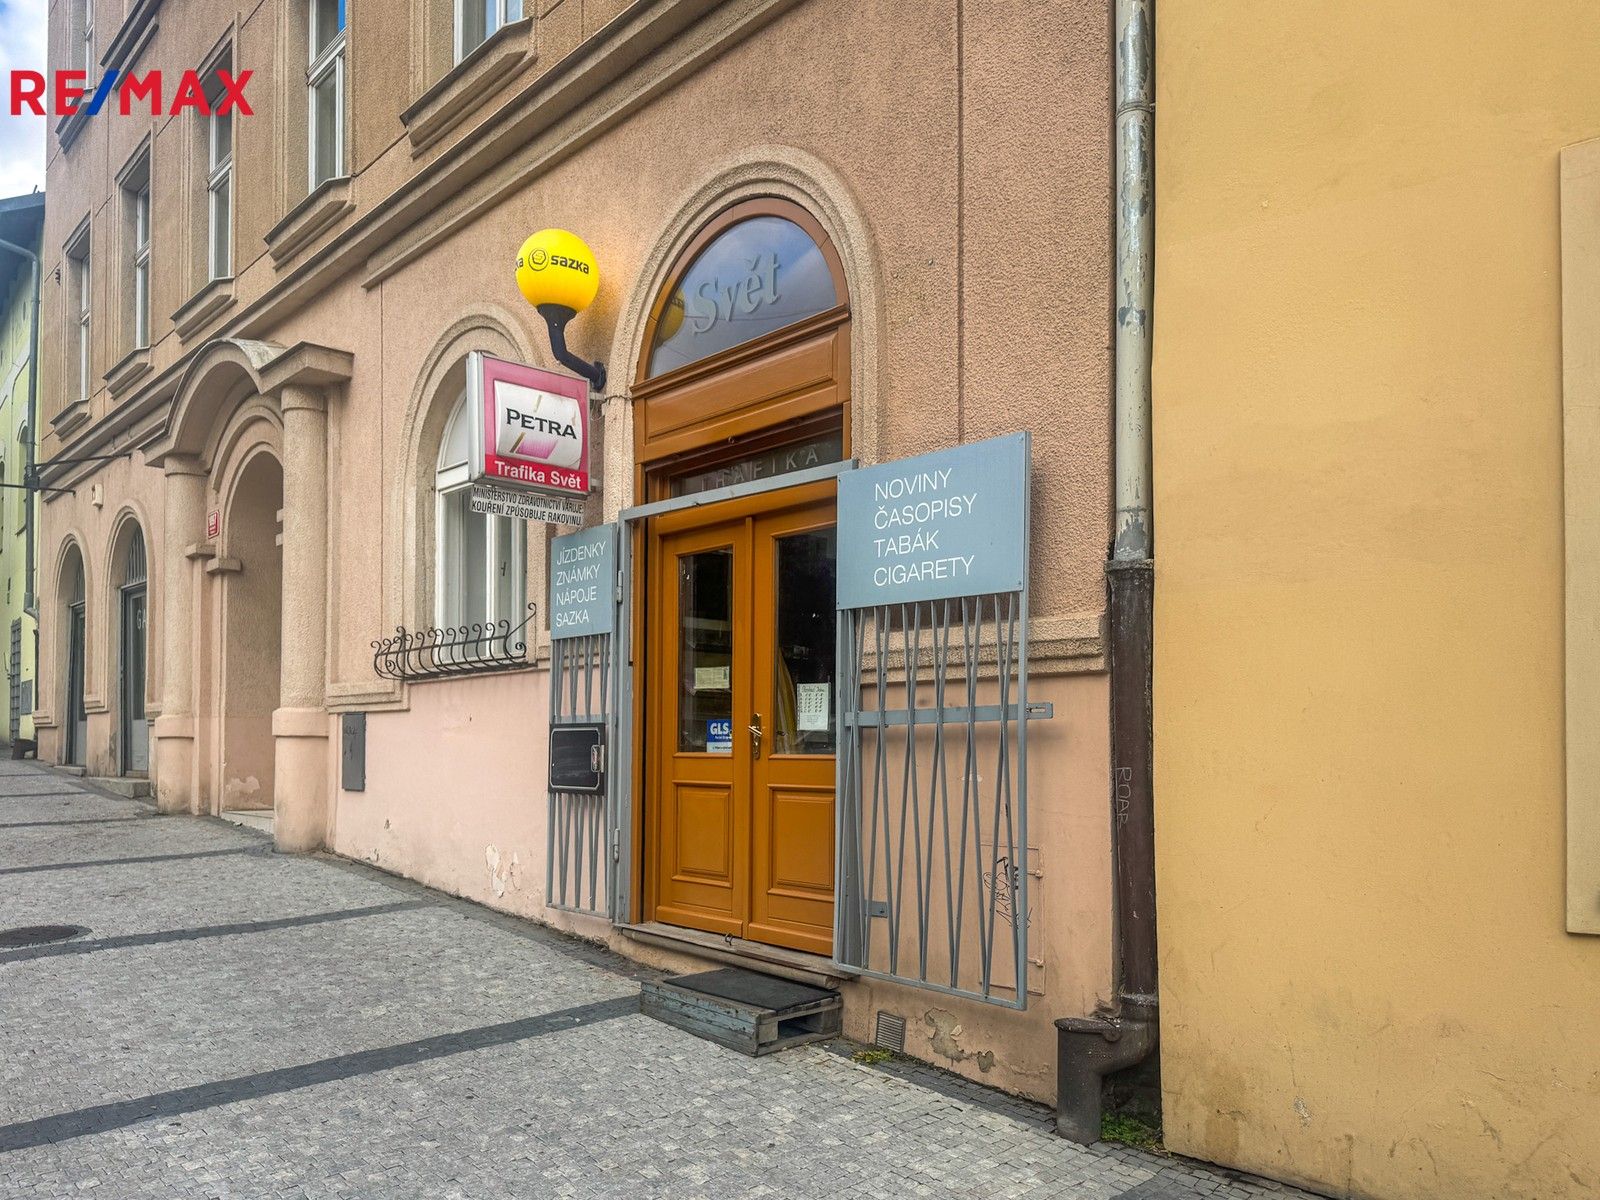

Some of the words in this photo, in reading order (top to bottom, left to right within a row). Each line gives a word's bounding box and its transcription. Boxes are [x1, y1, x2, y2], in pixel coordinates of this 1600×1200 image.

[551, 255, 589, 274] sazka
[693, 252, 782, 335] Svět
[506, 408, 577, 439] PETRA
[494, 460, 546, 484] Trafika
[550, 471, 582, 489] Svět
[874, 468, 953, 502] NOVINY
[471, 500, 504, 515] KOUŘENÍ
[505, 505, 546, 520] ZPŮSOBUJE
[873, 493, 978, 530] ČASOPISY
[556, 541, 606, 565] JÍZDENKY
[873, 529, 940, 558] TABÁK
[556, 563, 601, 586] ZNÁMKY
[873, 555, 976, 587] CIGARETY
[556, 585, 598, 606] NÁPOJE
[555, 609, 590, 628] SAZKA
[710, 722, 729, 736] GLS
